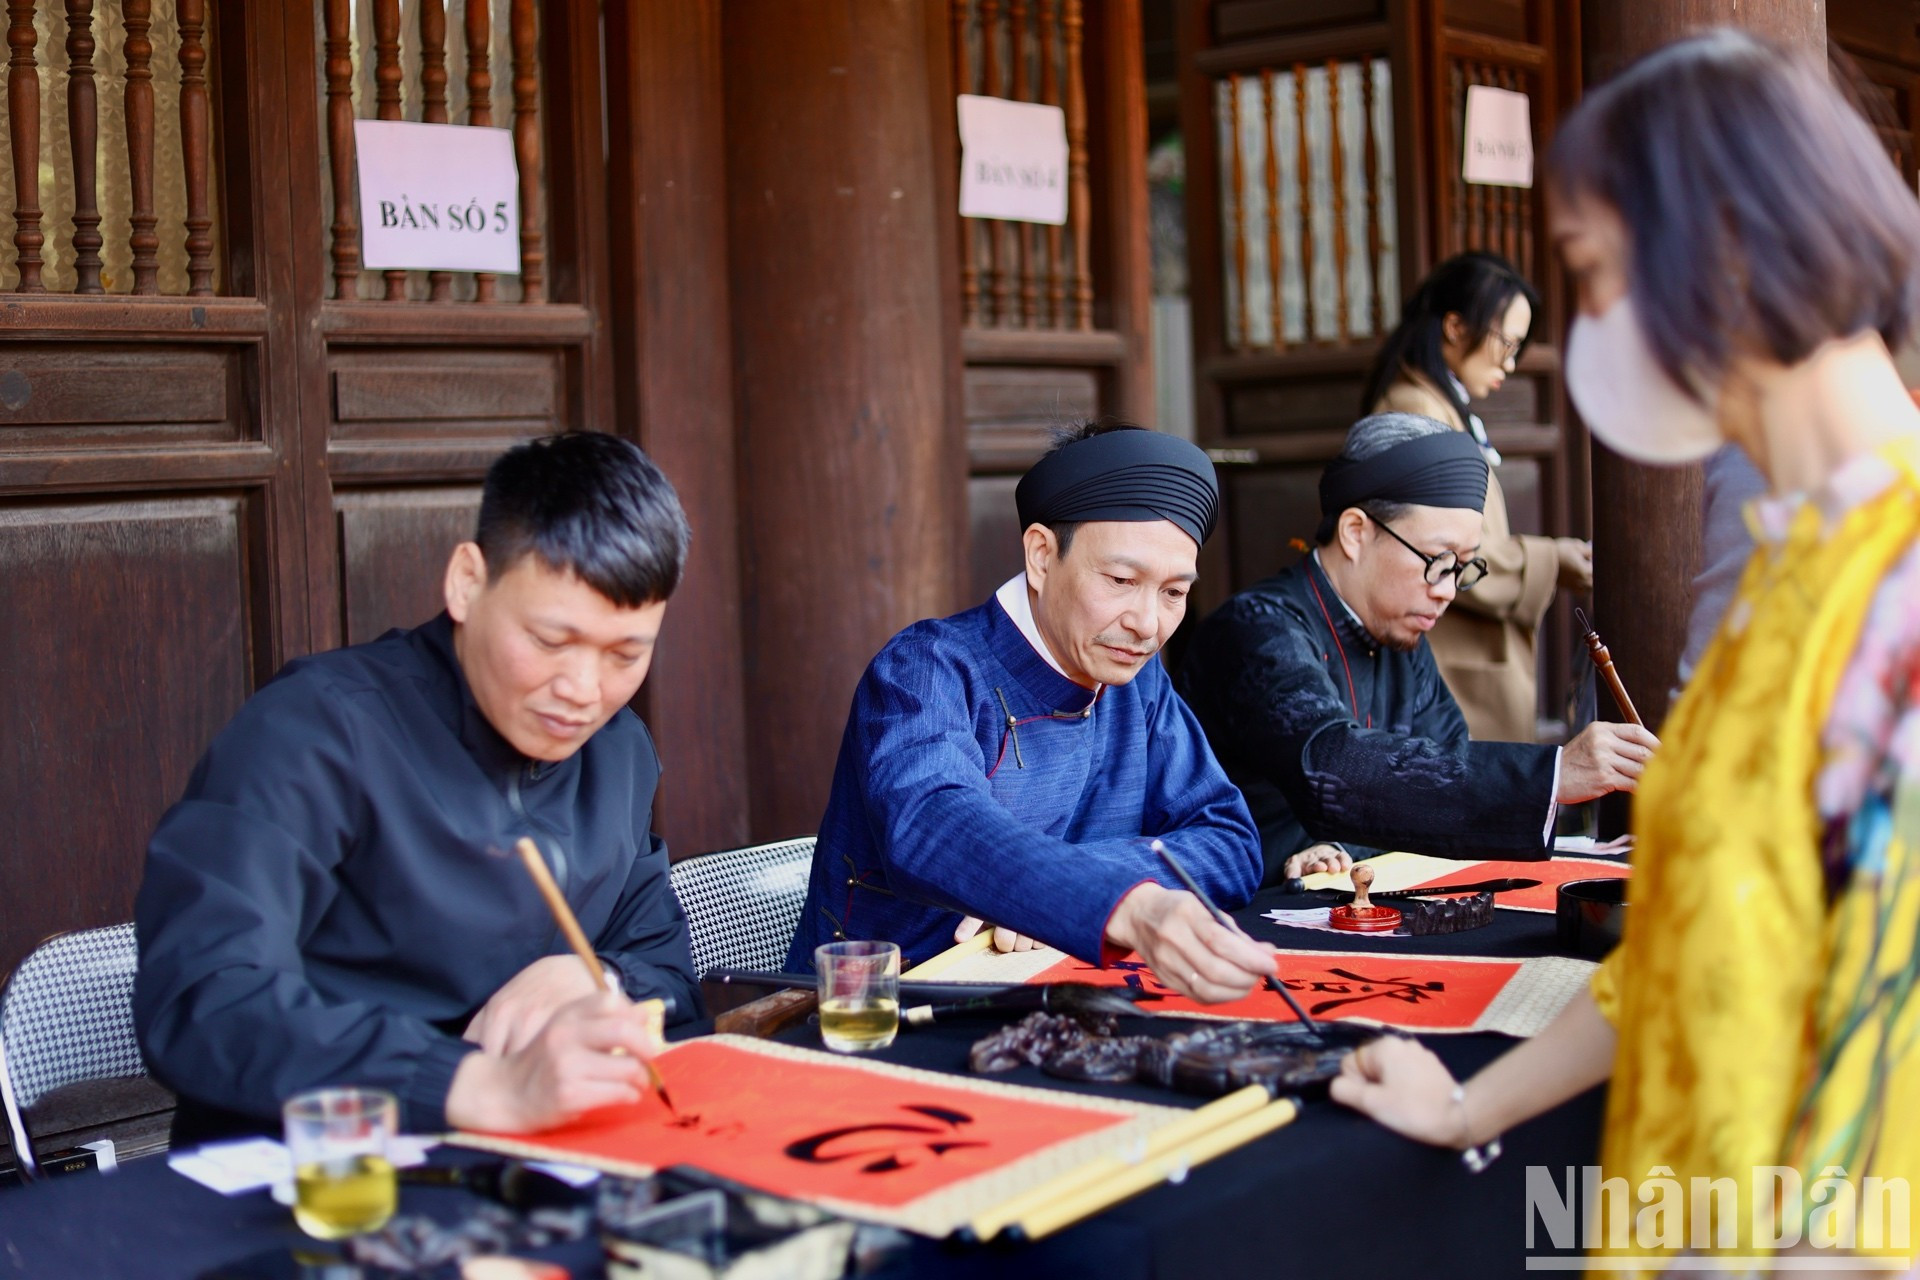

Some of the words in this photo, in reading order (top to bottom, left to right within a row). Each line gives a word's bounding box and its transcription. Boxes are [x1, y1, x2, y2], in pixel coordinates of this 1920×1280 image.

[379, 194, 440, 231] BÀN
[447, 197, 486, 233] SỐ
[493, 202, 508, 234] 5
